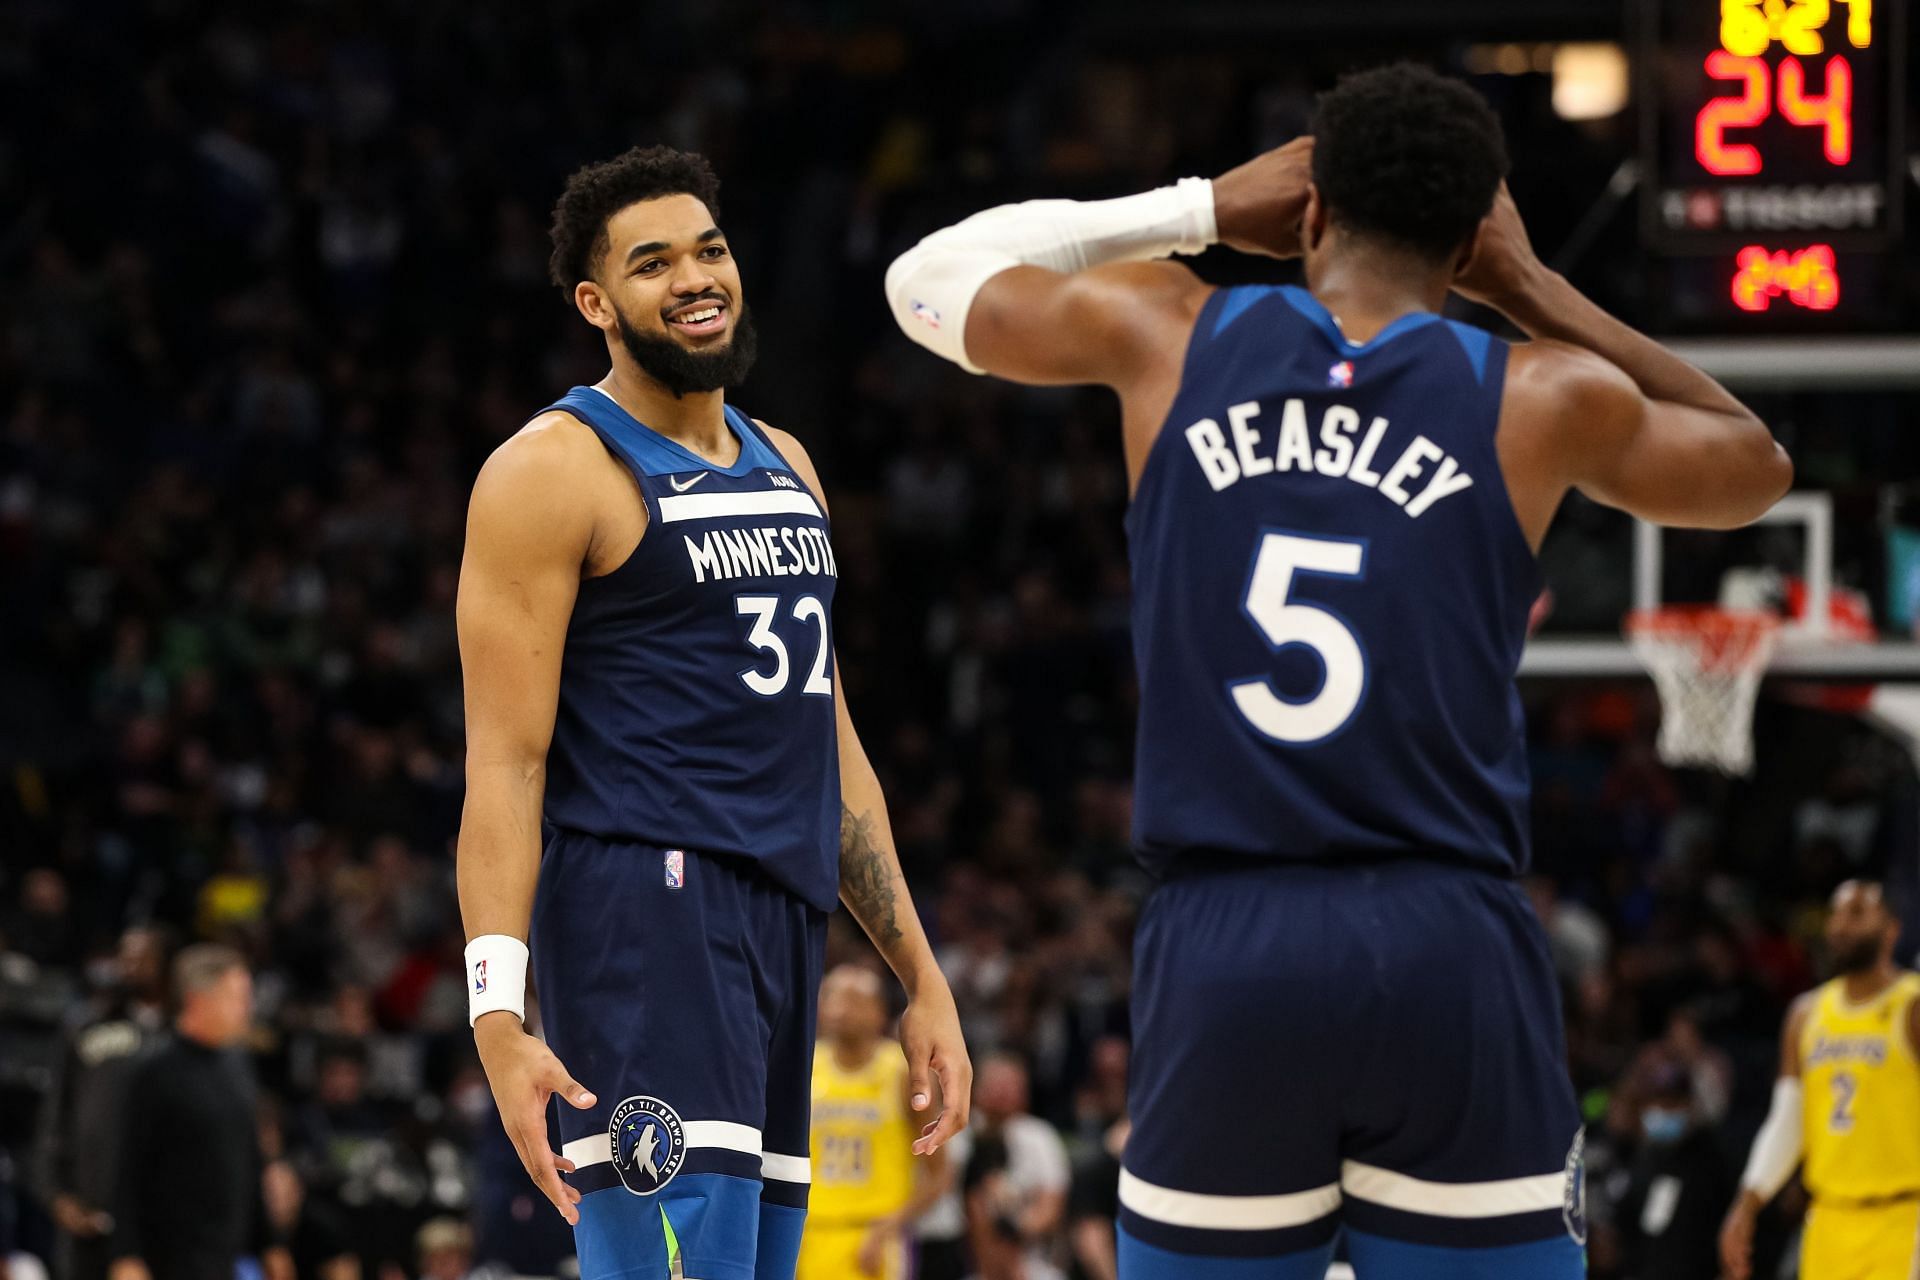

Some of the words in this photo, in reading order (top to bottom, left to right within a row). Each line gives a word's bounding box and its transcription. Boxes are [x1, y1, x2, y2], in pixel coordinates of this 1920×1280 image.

[1695, 50, 1852, 175] 24
[1185, 398, 1474, 518] BEASLEY
[736, 595, 832, 696] 32
[1231, 533, 1364, 742] 5
[640, 1101, 682, 1175] TIBERWOVES
[1830, 1072, 1857, 1134] 2
